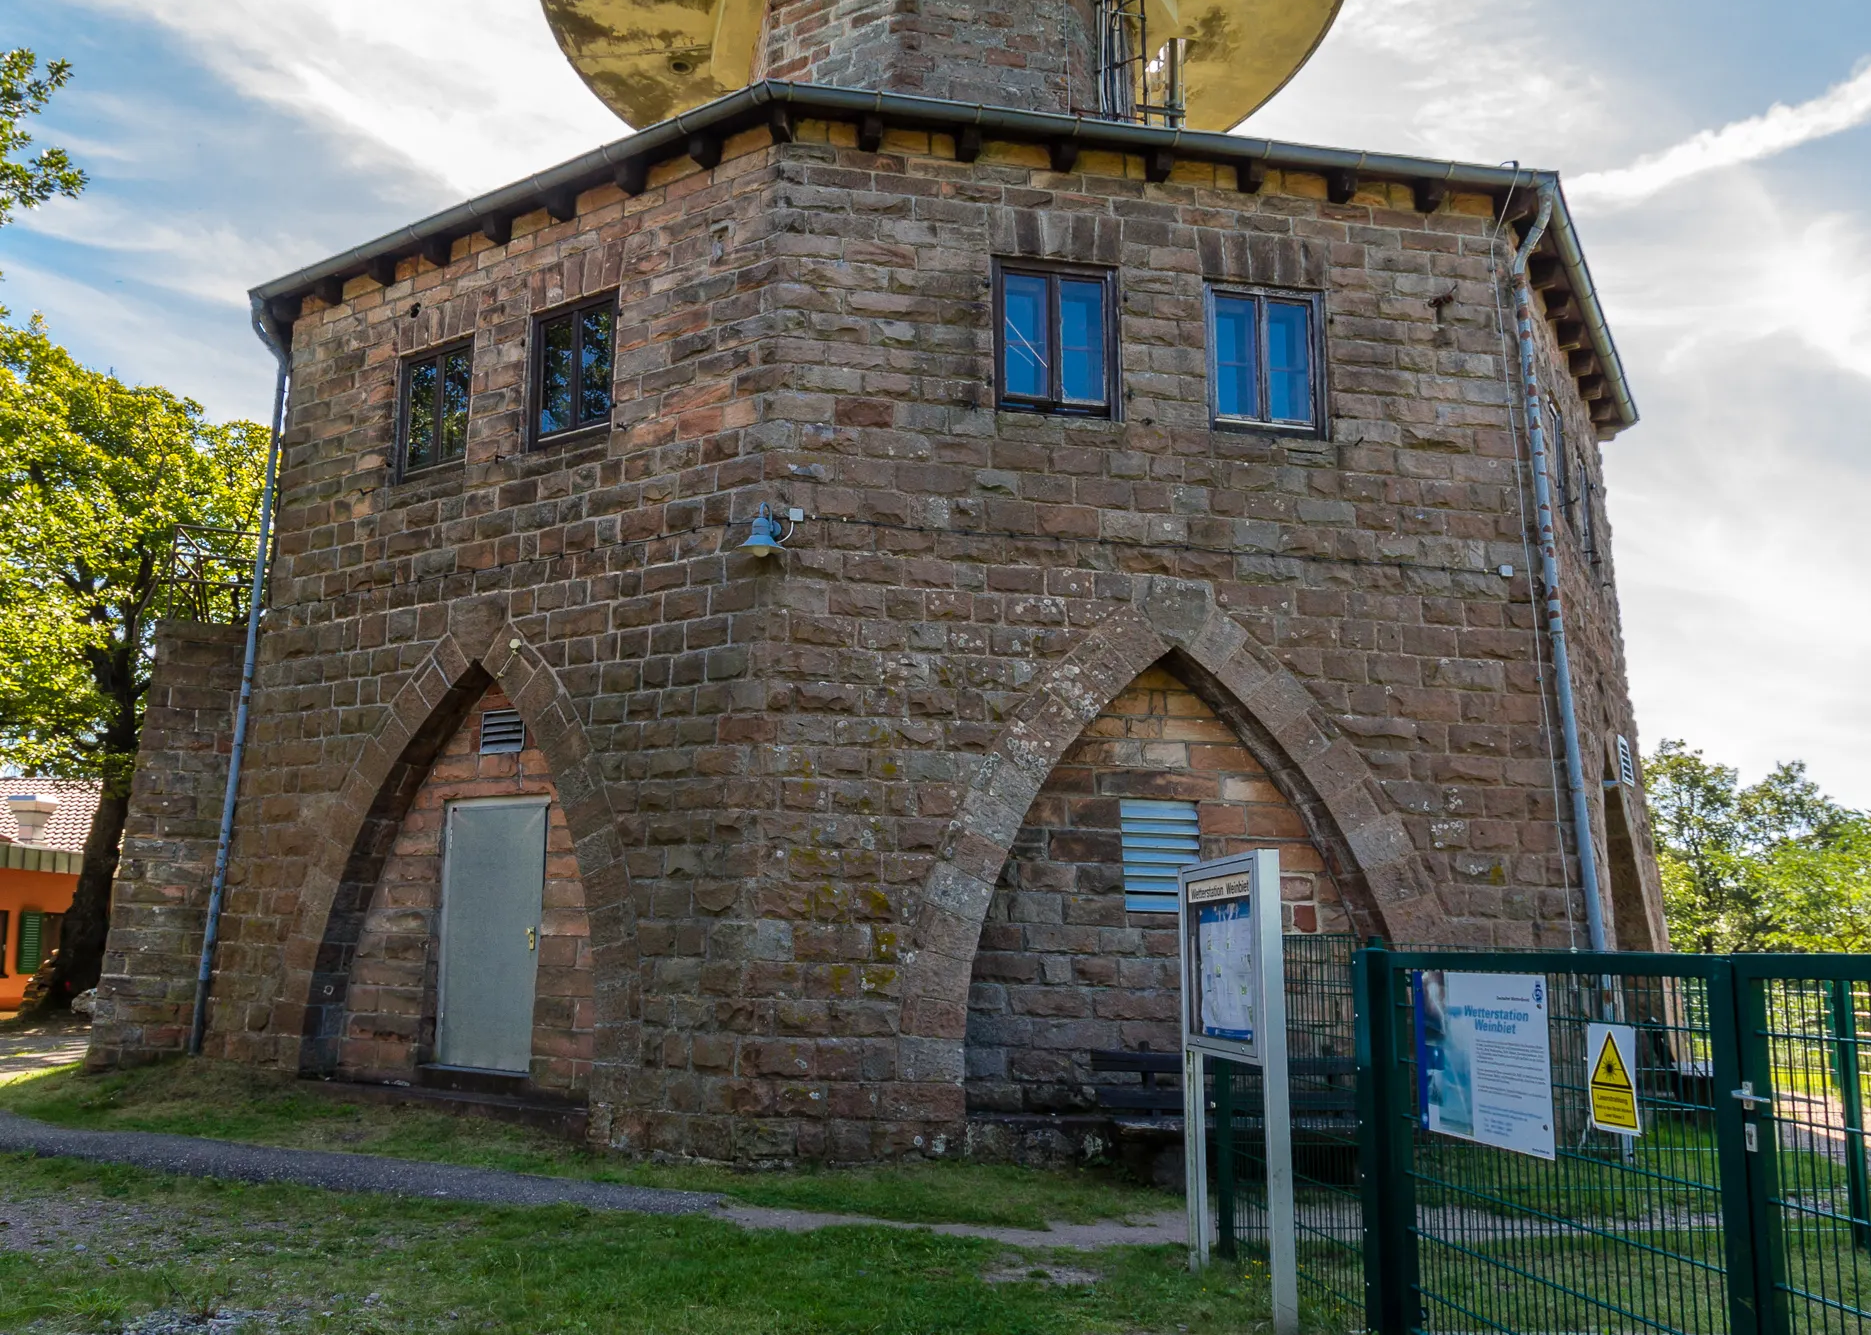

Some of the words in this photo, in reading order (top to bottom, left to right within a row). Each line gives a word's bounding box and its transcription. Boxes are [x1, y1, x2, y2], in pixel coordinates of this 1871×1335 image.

[1191, 885, 1224, 900] Wetterstation
[1226, 880, 1250, 895] Weinbiet
[1464, 1005, 1529, 1022] Wetterstation
[1474, 1018, 1516, 1034] Weinbiet
[1597, 1094, 1628, 1105] Laserstrahlung
